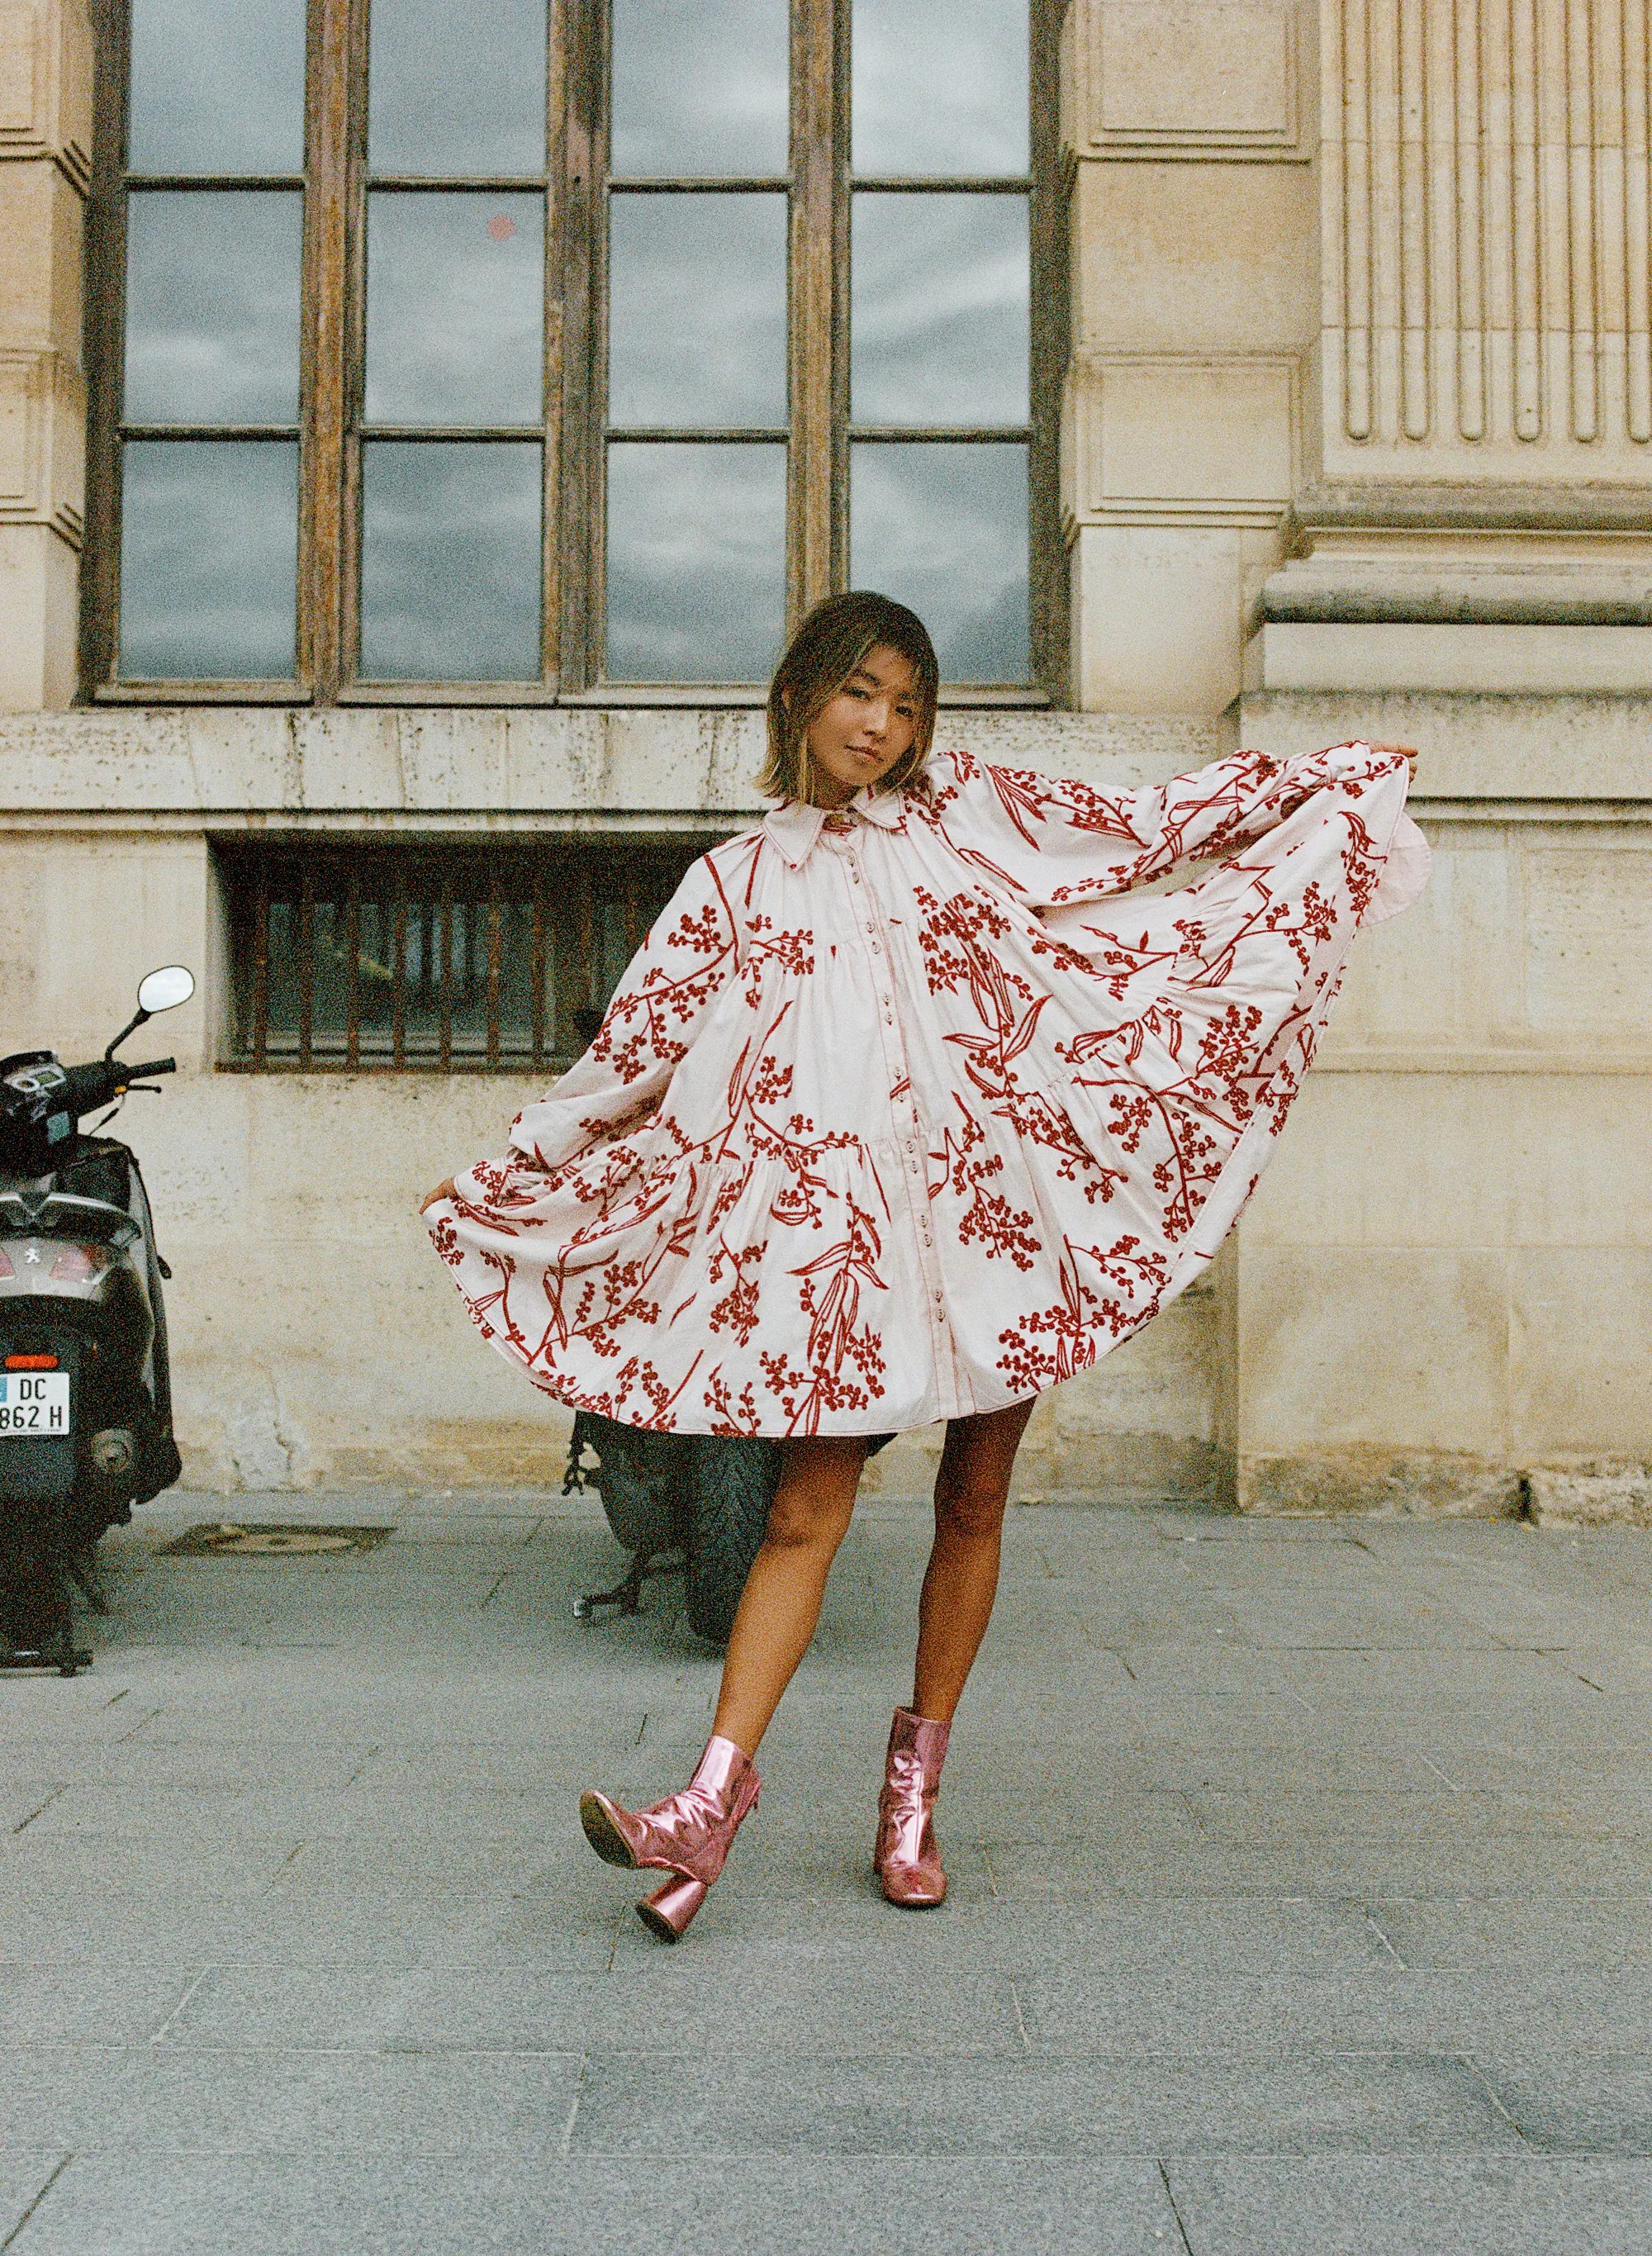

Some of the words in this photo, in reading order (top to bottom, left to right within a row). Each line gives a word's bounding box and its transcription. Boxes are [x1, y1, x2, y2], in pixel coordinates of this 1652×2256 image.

[20, 1378, 46, 1400] DC
[0, 1405, 40, 1430] 862
[50, 1405, 62, 1427] H
